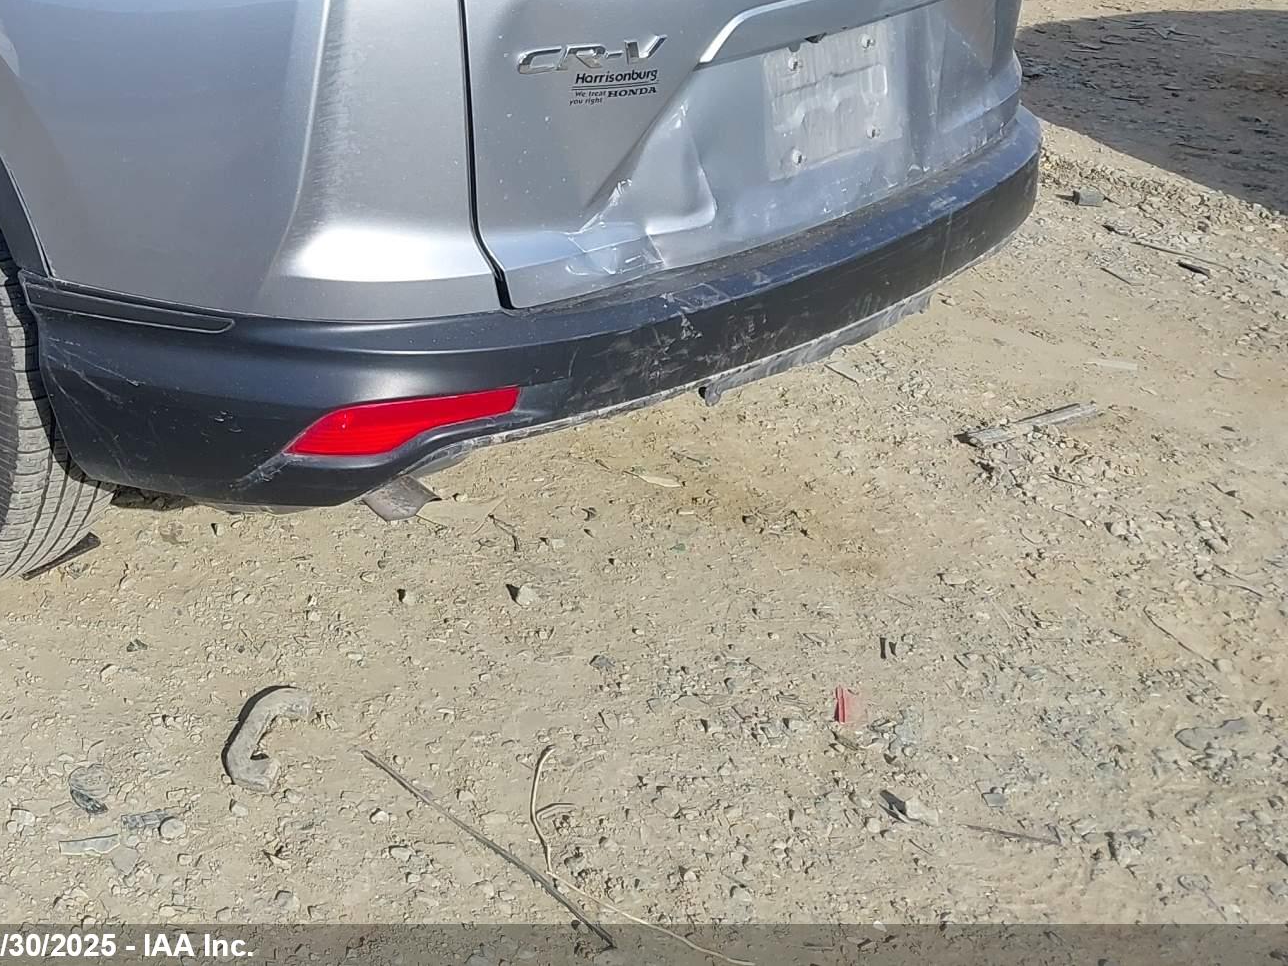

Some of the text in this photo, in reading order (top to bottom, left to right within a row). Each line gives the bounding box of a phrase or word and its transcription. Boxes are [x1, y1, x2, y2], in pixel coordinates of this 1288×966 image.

[517, 34, 668, 75] CR-V
[575, 69, 659, 85] Harrisonburg
[574, 90, 607, 98] We treat
[607, 86, 657, 98] HONDA
[585, 97, 603, 105] right
